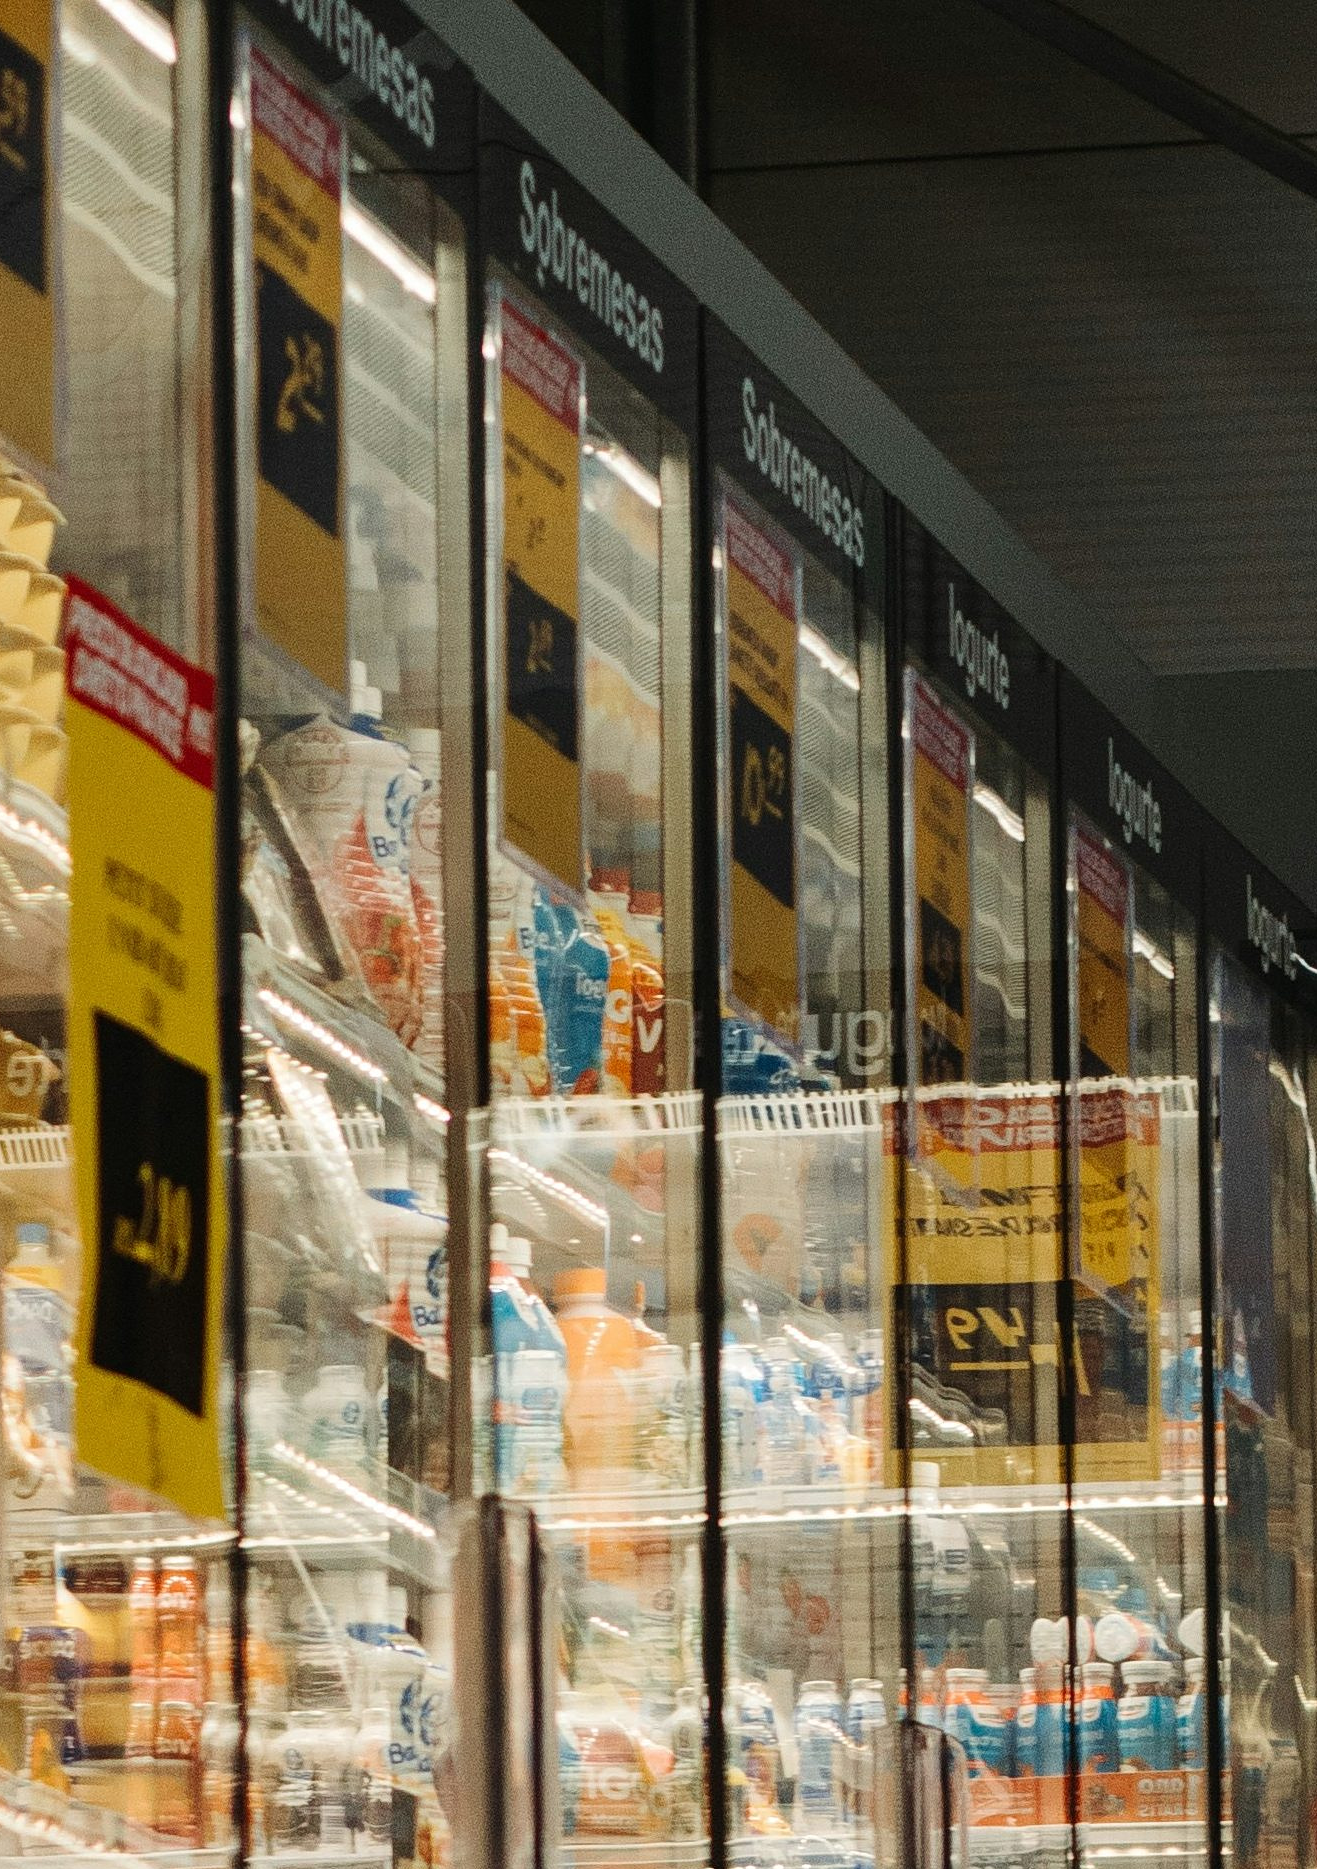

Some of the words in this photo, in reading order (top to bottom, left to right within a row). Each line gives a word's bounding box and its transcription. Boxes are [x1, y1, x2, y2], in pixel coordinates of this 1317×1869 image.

[519, 159, 664, 373] Sobremesas
[741, 376, 865, 567] Sobremesas
[948, 581, 1009, 710] Iogurte
